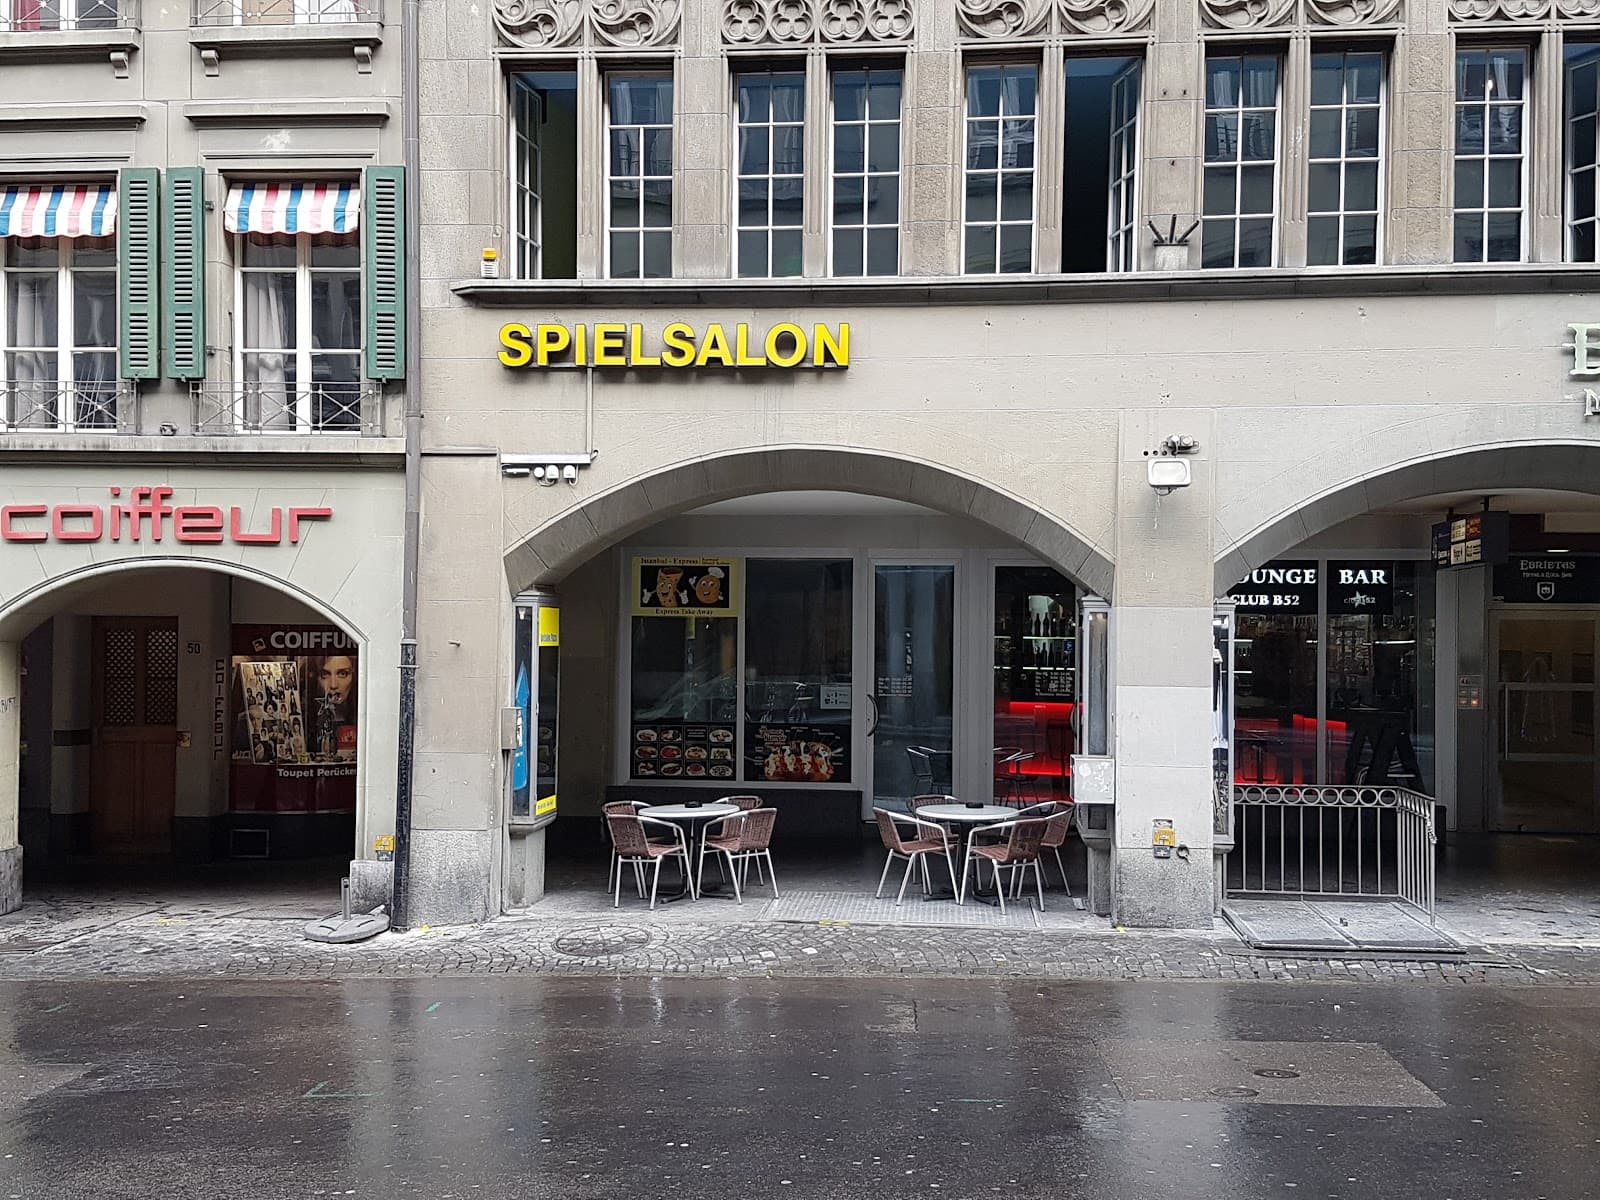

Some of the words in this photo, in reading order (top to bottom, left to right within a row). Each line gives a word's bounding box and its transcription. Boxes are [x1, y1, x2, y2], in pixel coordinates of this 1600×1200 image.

[497, 322, 850, 367] SPIELSALON
[1, 486, 333, 544] coiffeur
[1338, 569, 1388, 585] BAR
[1230, 594, 1270, 606] CLUB
[1272, 594, 1300, 606] B52
[187, 642, 201, 654] 50
[277, 768, 314, 779] Toupet
